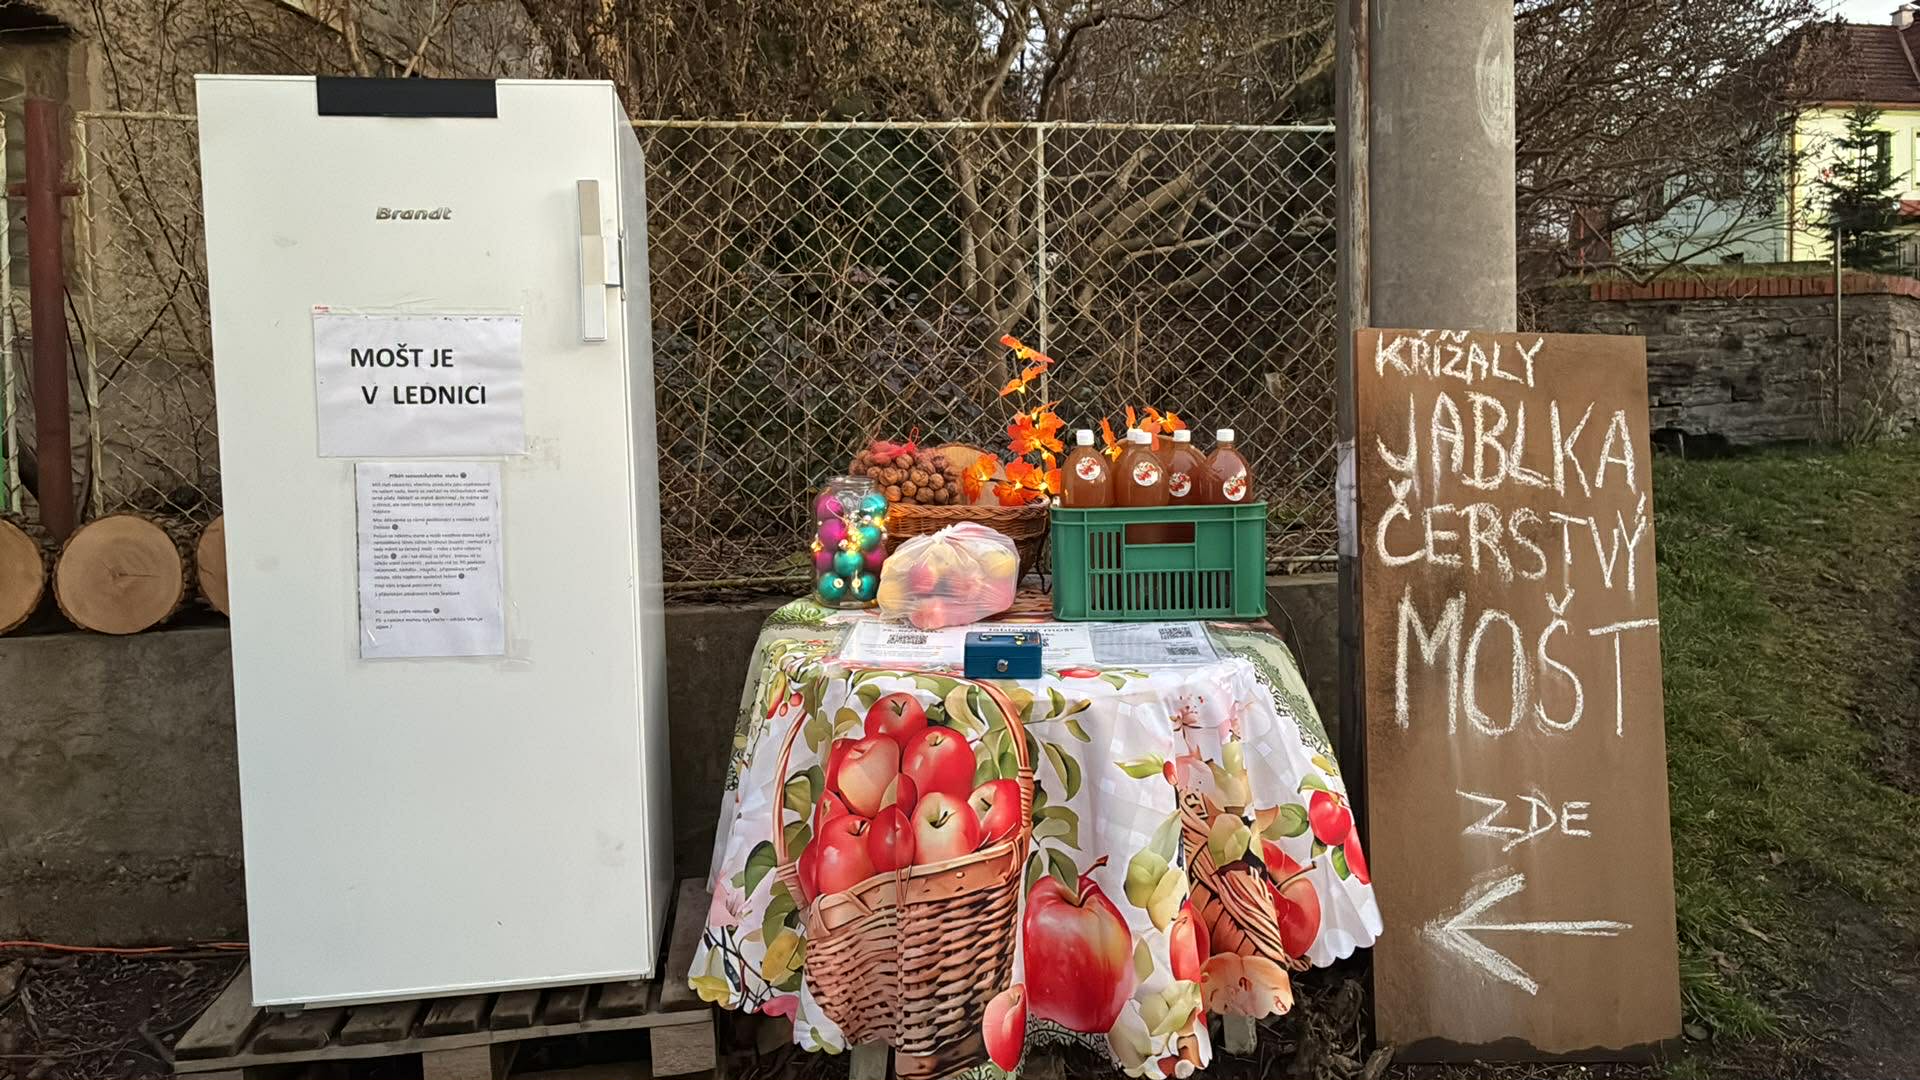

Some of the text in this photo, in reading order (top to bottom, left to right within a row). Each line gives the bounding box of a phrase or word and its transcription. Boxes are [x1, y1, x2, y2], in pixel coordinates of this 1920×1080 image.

[376, 206, 452, 221] Brandt
[351, 343, 454, 368] MOŠT JE
[362, 386, 486, 404] V LEDNICI
[1377, 391, 1637, 498] JABLKA
[1376, 478, 1650, 592] ČERSTVÝ
[1395, 585, 1660, 737] MOŠT
[1455, 784, 1593, 853] ZDE
